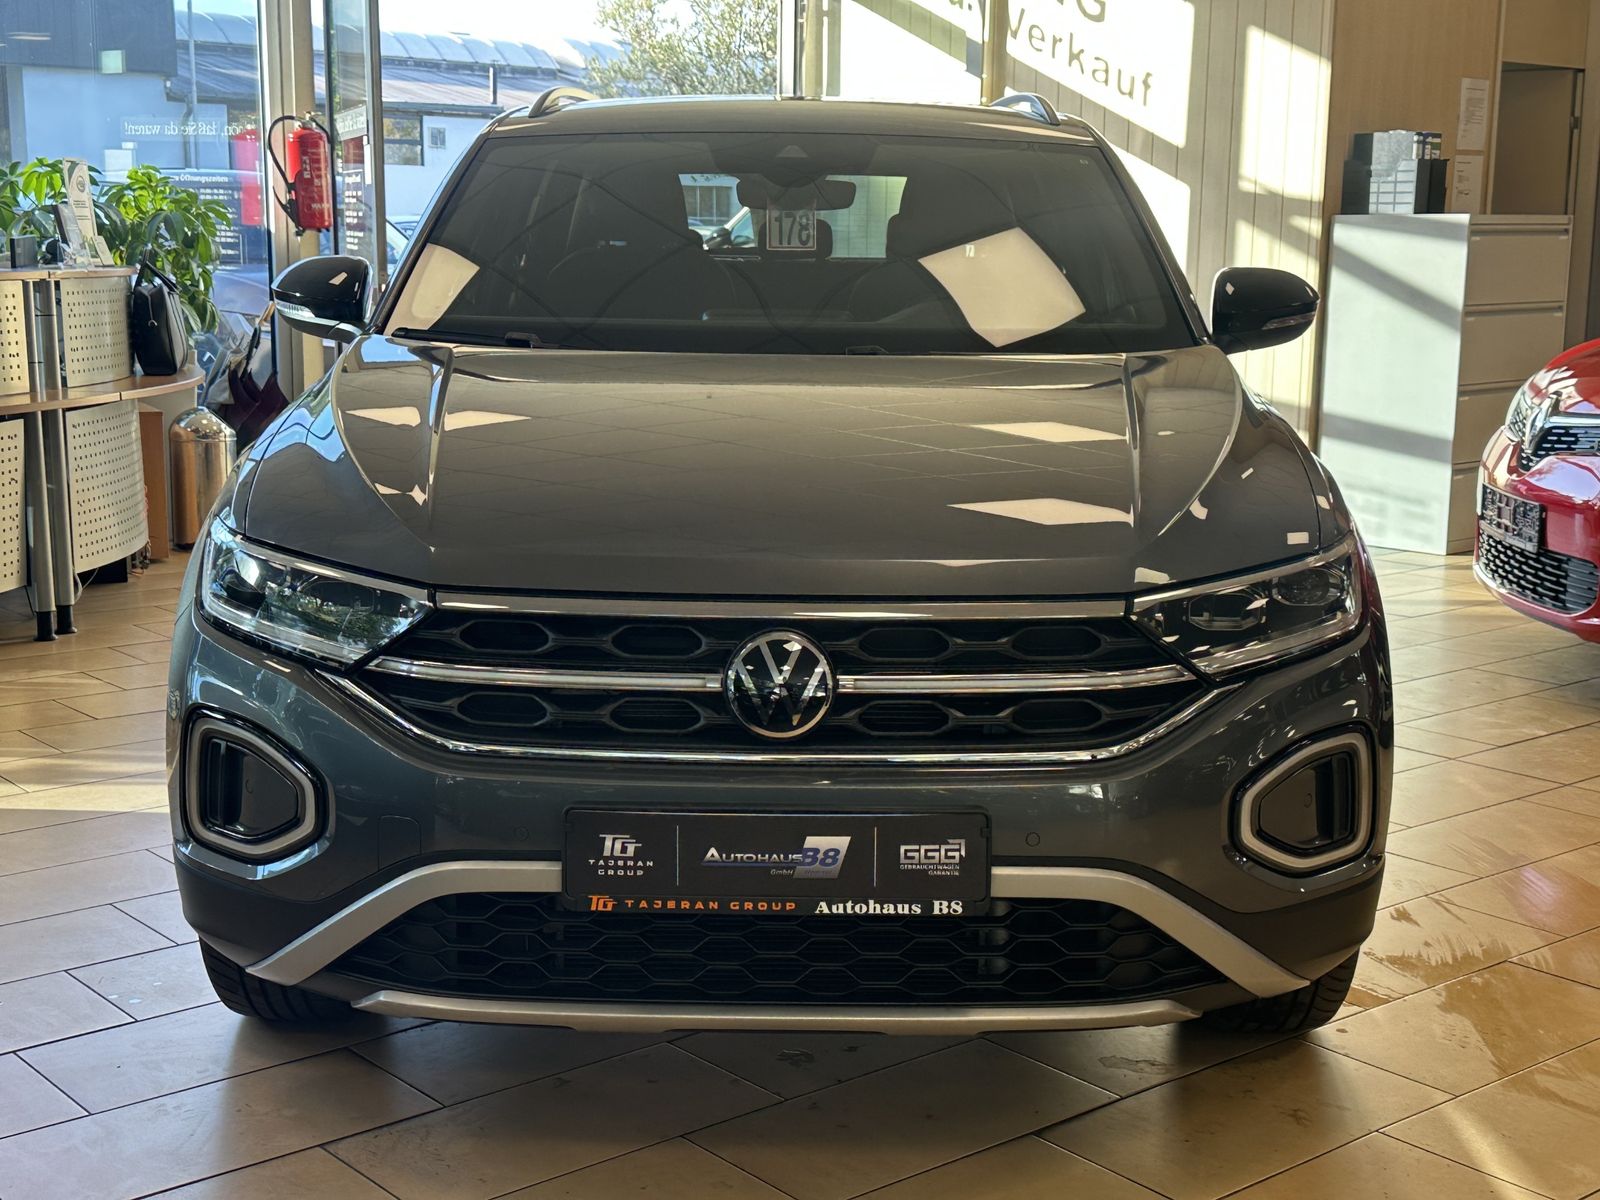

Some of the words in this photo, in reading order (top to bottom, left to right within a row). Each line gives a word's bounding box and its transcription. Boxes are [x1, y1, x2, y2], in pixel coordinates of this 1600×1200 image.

[1007, 8, 1153, 107] Verkauf
[774, 211, 811, 246] 178
[599, 834, 642, 857] TG
[900, 844, 960, 864] GGG
[588, 859, 654, 867] TAJERAN
[770, 868, 794, 876] GmbH
[624, 899, 719, 910] TAJERAN
[729, 901, 797, 911] GROUP
[814, 899, 922, 915] Autohaus
[931, 900, 964, 915] B8
